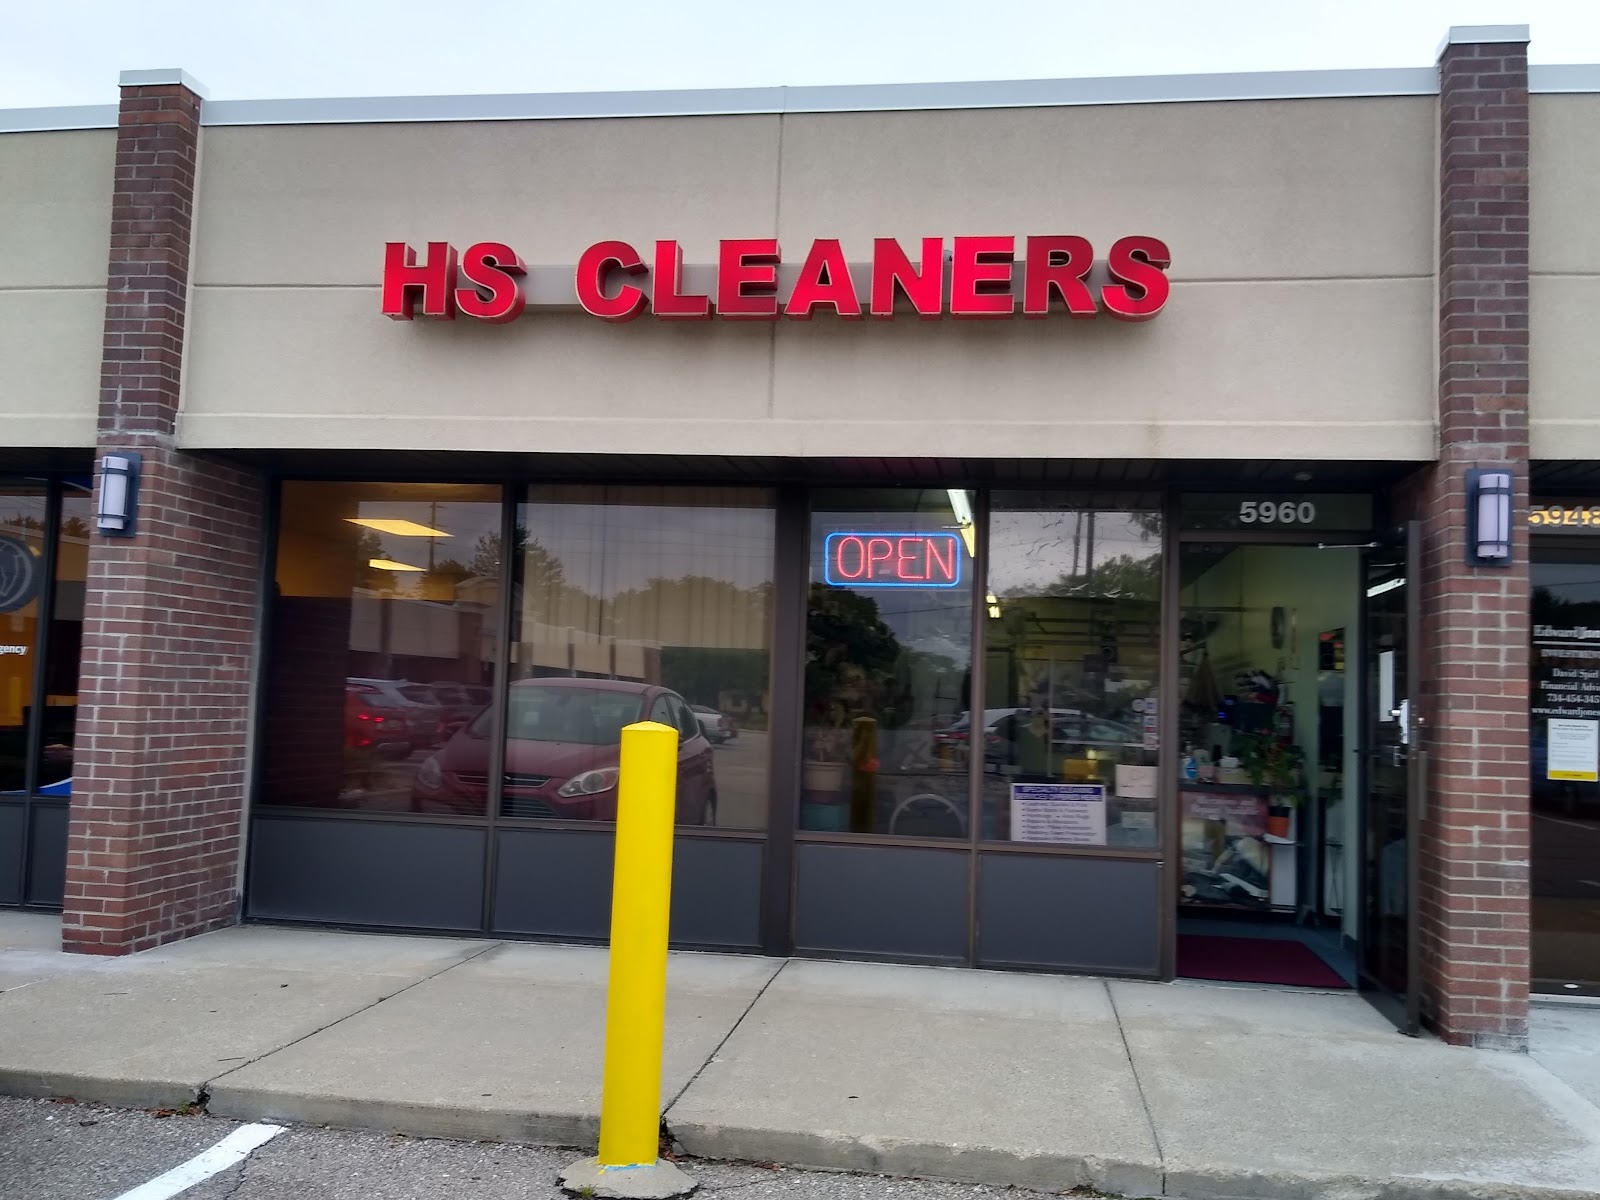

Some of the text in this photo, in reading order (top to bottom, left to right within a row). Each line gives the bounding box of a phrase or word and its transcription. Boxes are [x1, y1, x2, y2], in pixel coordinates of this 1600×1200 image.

[382, 236, 1171, 323] HS CLEANERS
[1239, 501, 1315, 524] 5960
[1528, 505, 1600, 528] 5948
[838, 536, 954, 580] OPEN
[1552, 668, 1577, 678] David
[1540, 680, 1578, 691] Financial
[1546, 693, 1600, 704] 734-454-345
